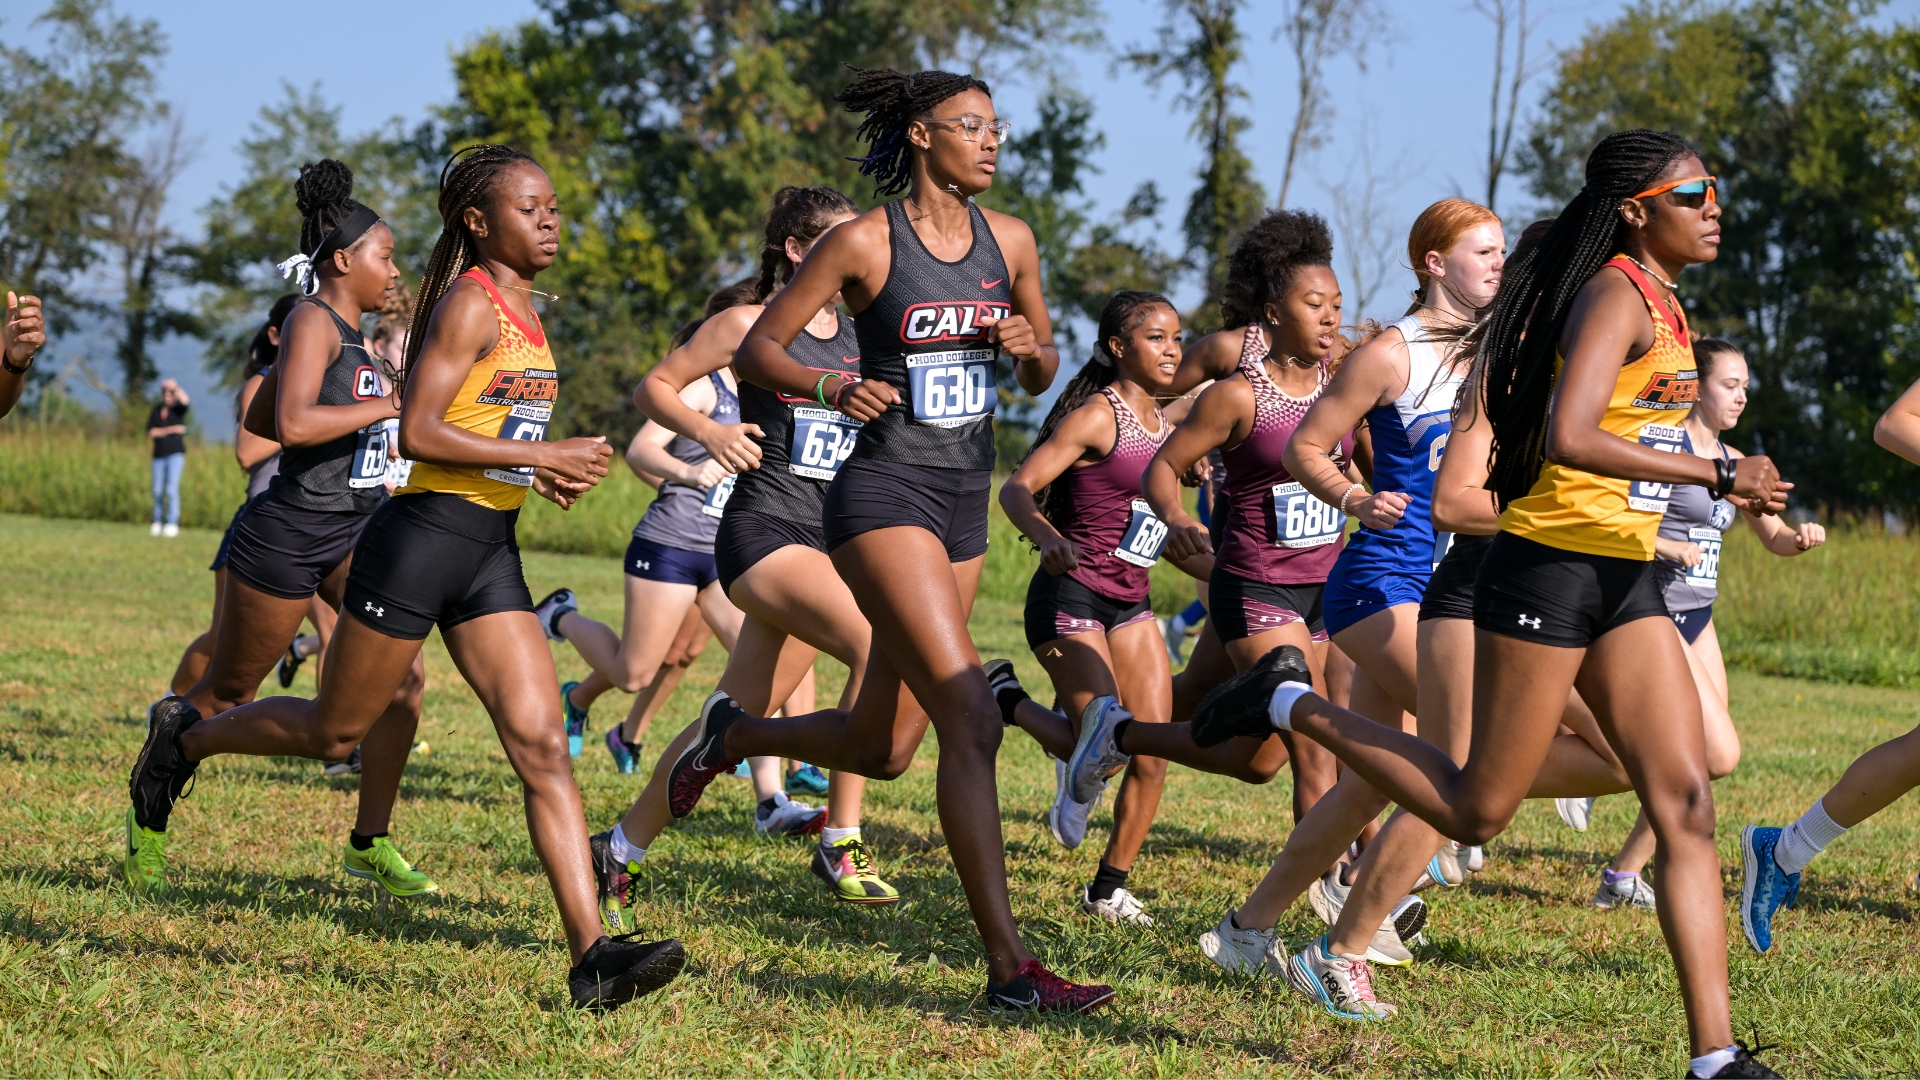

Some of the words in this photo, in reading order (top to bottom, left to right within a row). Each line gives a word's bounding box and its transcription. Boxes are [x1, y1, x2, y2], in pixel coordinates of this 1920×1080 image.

[914, 355, 944, 365] HOOD
[946, 351, 987, 362] COLLEGE
[924, 364, 987, 417] 630
[514, 406, 536, 418] HOOD
[801, 409, 828, 419] HOOD
[1648, 425, 1675, 439] HOOD
[801, 422, 859, 469] 634
[499, 473, 519, 483] CROSS
[1280, 483, 1304, 493] HOOD
[1285, 494, 1339, 539] 680
[1129, 516, 1169, 559] 681
